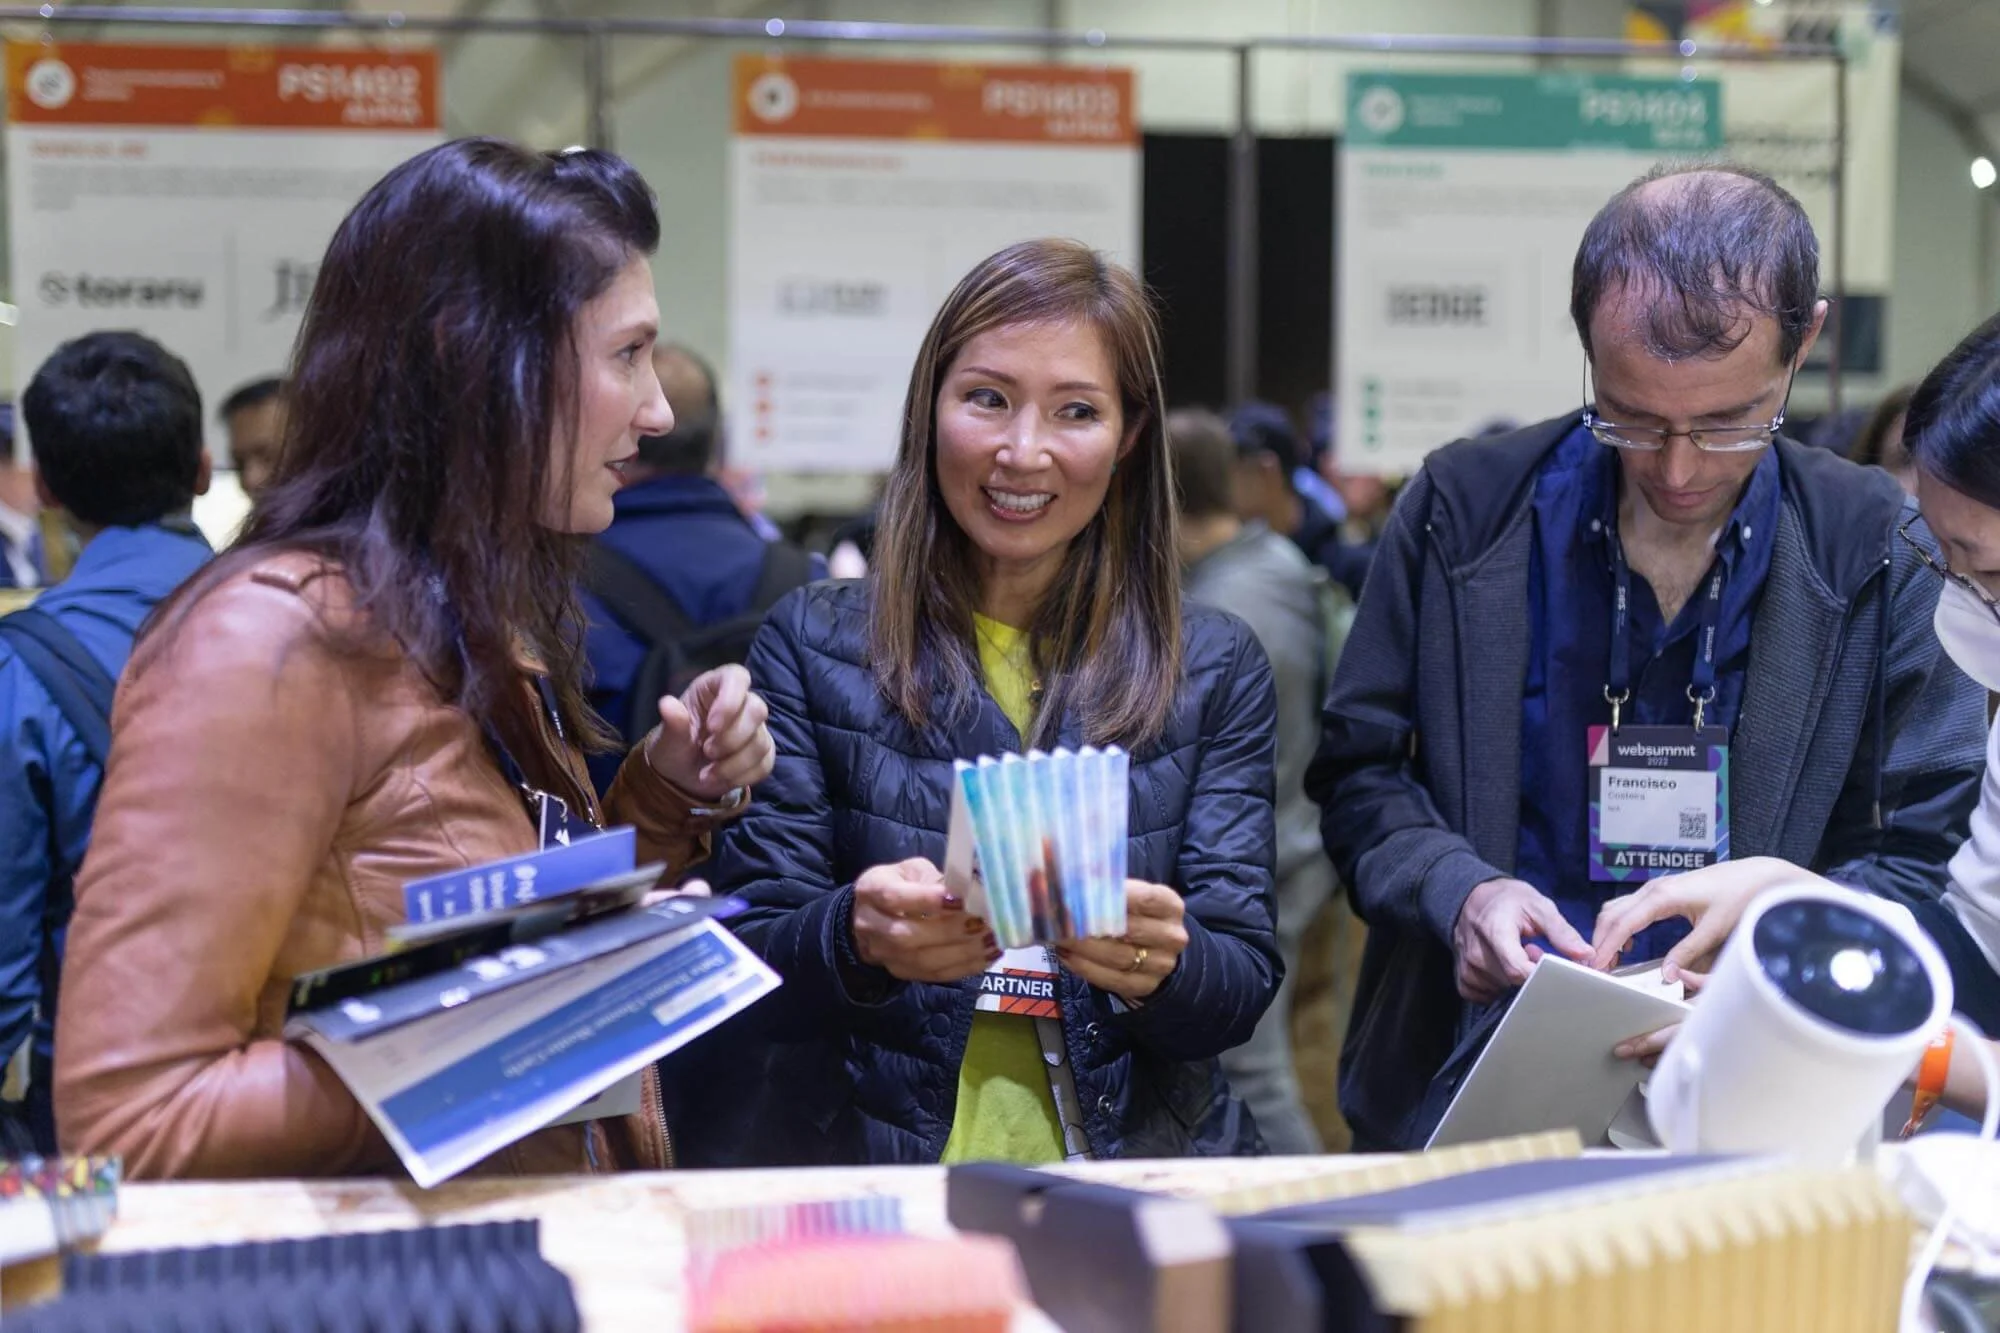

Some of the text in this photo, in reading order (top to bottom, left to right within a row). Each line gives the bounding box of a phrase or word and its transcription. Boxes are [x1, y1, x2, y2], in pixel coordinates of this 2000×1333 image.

[1618, 742, 1697, 757] websummit
[1647, 757, 1669, 766] 2022
[1608, 776, 1677, 790] Francisco
[1614, 851, 1705, 868] ATTENDEE
[980, 975, 1054, 998] ARTNER
